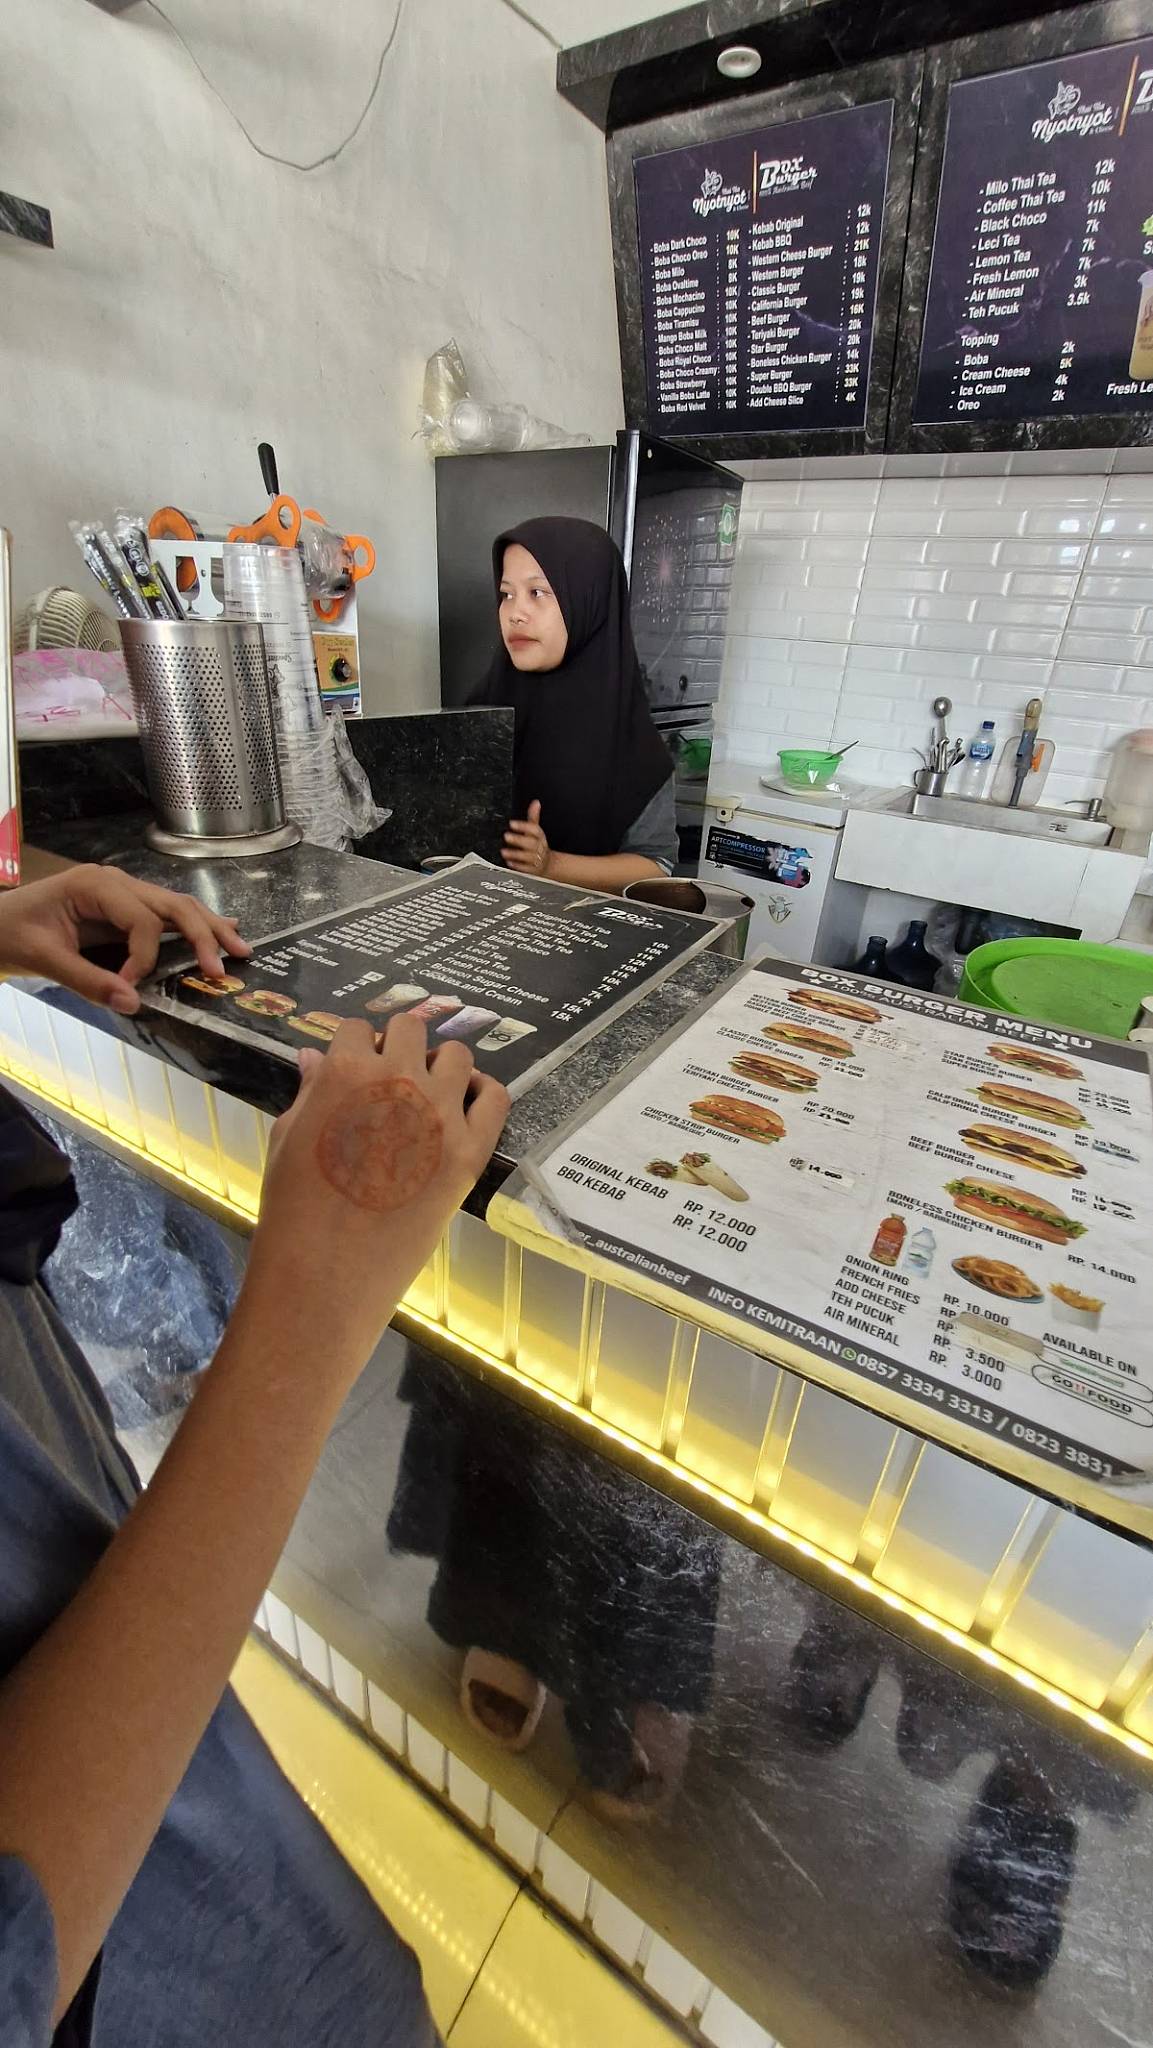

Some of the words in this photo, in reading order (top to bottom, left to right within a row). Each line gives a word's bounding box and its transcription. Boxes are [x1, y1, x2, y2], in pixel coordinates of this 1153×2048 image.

[1032, 106, 1113, 143] Nyotnyot
[760, 156, 803, 190] Box
[986, 180, 1008, 196] Milo
[1012, 174, 1035, 190] Thai
[1037, 171, 1056, 186] Tea
[1095, 158, 1115, 176] 12k
[693, 190, 747, 217] Nyotnyot
[983, 197, 1017, 214] Coffee
[1021, 192, 1043, 208] Thai
[1047, 189, 1066, 203] Tea
[1091, 179, 1111, 195] 10k
[752, 223, 775, 235] Kebab
[776, 216, 803, 231] Original
[857, 204, 871, 218] 12k
[980, 216, 1009, 233] Black
[1012, 212, 1047, 227] Choco
[1087, 199, 1107, 214] 11k
[654, 242, 670, 253] Boba
[671, 238, 685, 249] Dark
[686, 235, 707, 247] Choco
[752, 239, 774, 251] Kebab
[775, 234, 791, 247] BBQ
[856, 222, 870, 235] 12k
[978, 236, 1000, 251] Leci
[1002, 233, 1020, 245] Tea
[1086, 219, 1100, 233] 7k
[752, 254, 780, 267] Western
[781, 250, 807, 262] Cheese
[808, 244, 833, 258] Burger
[854, 239, 869, 251] 21K
[975, 254, 1010, 268] Lemon
[1013, 250, 1031, 261] Tea
[1082, 238, 1095, 252] 7k
[751, 285, 776, 296] Classic
[777, 282, 800, 294] Burger
[852, 272, 866, 284] 19k
[752, 270, 779, 282] Western
[780, 266, 804, 278] Burger
[973, 271, 1001, 286] Fresh
[1004, 267, 1039, 281] Lemon
[1078, 256, 1091, 271] 7k
[970, 290, 985, 302] Air
[987, 284, 1024, 300] Mineral
[1074, 274, 1088, 288] 3k
[969, 306, 985, 319] Teh
[988, 302, 1020, 317] Pucuk
[1067, 292, 1091, 306] 3.5k
[961, 333, 999, 348] Topping
[964, 354, 989, 366] Boba
[1061, 341, 1075, 353] 2k
[751, 356, 779, 367] Boneless
[781, 353, 808, 365] Chicken
[809, 351, 832, 363] Burger
[962, 369, 992, 381] Cream
[995, 366, 1031, 378] Cheese
[957, 401, 980, 411] Oreo
[1051, 389, 1065, 402] 2k
[959, 386, 973, 396] Ice
[975, 383, 1006, 395] Cream
[1055, 374, 1069, 385] 4k
[1106, 382, 1138, 396] Fresh
[661, 404, 675, 413] Boba
[677, 403, 688, 412] Red
[750, 398, 763, 407] Add
[764, 396, 787, 407] Cheese
[788, 396, 803, 405] Slice
[487, 935, 515, 947] Black
[517, 943, 550, 956] Choco
[443, 957, 474, 970] Fresh
[475, 966, 511, 982] Lemon
[454, 951, 490, 966] Lemon
[491, 961, 511, 972] Tea
[473, 974, 505, 990] Sugar
[507, 986, 550, 1003] Cheese
[561, 1003, 583, 1015] 15k
[485, 990, 523, 1007] Cream
[550, 1011, 573, 1023] 15k
[800, 968, 856, 988] BOX
[864, 983, 988, 1022] BURGER
[996, 1018, 1093, 1049] MENU
[879, 995, 990, 1030] AUSTRALIAN
[682, 1068, 716, 1083] TERIYAKI
[716, 1080, 747, 1093] CHEESE
[747, 1088, 780, 1103] BURGER
[686, 1063, 720, 1079] TERIYAKI
[721, 1074, 752, 1088] BURGER
[644, 1106, 680, 1123] CHICKEN
[681, 1118, 706, 1131] STRIP
[705, 1128, 740, 1145] BURGER
[908, 1141, 931, 1152] BEEF
[934, 1150, 974, 1167] BURGER
[976, 1163, 1016, 1181] CHEESE
[911, 1135, 935, 1147] BEEF
[936, 1144, 976, 1161] BURGER
[557, 1165, 585, 1183] BBQ
[584, 1176, 627, 1201] KEBAB
[569, 1153, 625, 1182] ORIGINAL
[625, 1175, 669, 1199] KEBAB
[683, 1199, 704, 1216] RP.
[709, 1209, 757, 1236] 12.000
[888, 1190, 943, 1215] BONELESS
[945, 1210, 994, 1233] CHICKEN
[996, 1229, 1044, 1251] BURGER
[672, 1214, 693, 1230] RP.
[699, 1224, 748, 1253] 12.000
[1067, 1254, 1086, 1266] RP.
[1091, 1263, 1137, 1284] 14.000
[835, 1278, 859, 1293] ADD
[861, 1288, 907, 1314] CHEESE
[840, 1266, 885, 1289] FRENCH
[887, 1284, 921, 1305] FRIES
[845, 1254, 879, 1275] ONION
[882, 1269, 910, 1286] RING
[943, 1293, 960, 1308] RP.
[966, 1302, 1010, 1326] 10.000
[831, 1291, 852, 1307] TEH
[854, 1301, 896, 1325] PUCUK
[933, 1334, 951, 1350] RP.
[965, 1348, 1005, 1372] 3.500
[824, 1305, 845, 1322] AIR
[846, 1315, 900, 1347] MINERAL
[929, 1351, 947, 1368] RP.
[962, 1364, 1002, 1391] 3.000
[1042, 1332, 1115, 1367] AVAILABLE
[1118, 1361, 1137, 1376] ON
[708, 1286, 745, 1311] INFO
[746, 1303, 843, 1355] KEMITRAAN
[856, 1351, 899, 1381] 0857
[900, 1373, 945, 1402] 3334
[949, 1394, 994, 1424] 3313
[1011, 1423, 1060, 1454] 0823
[1065, 1448, 1114, 1478] 3831
